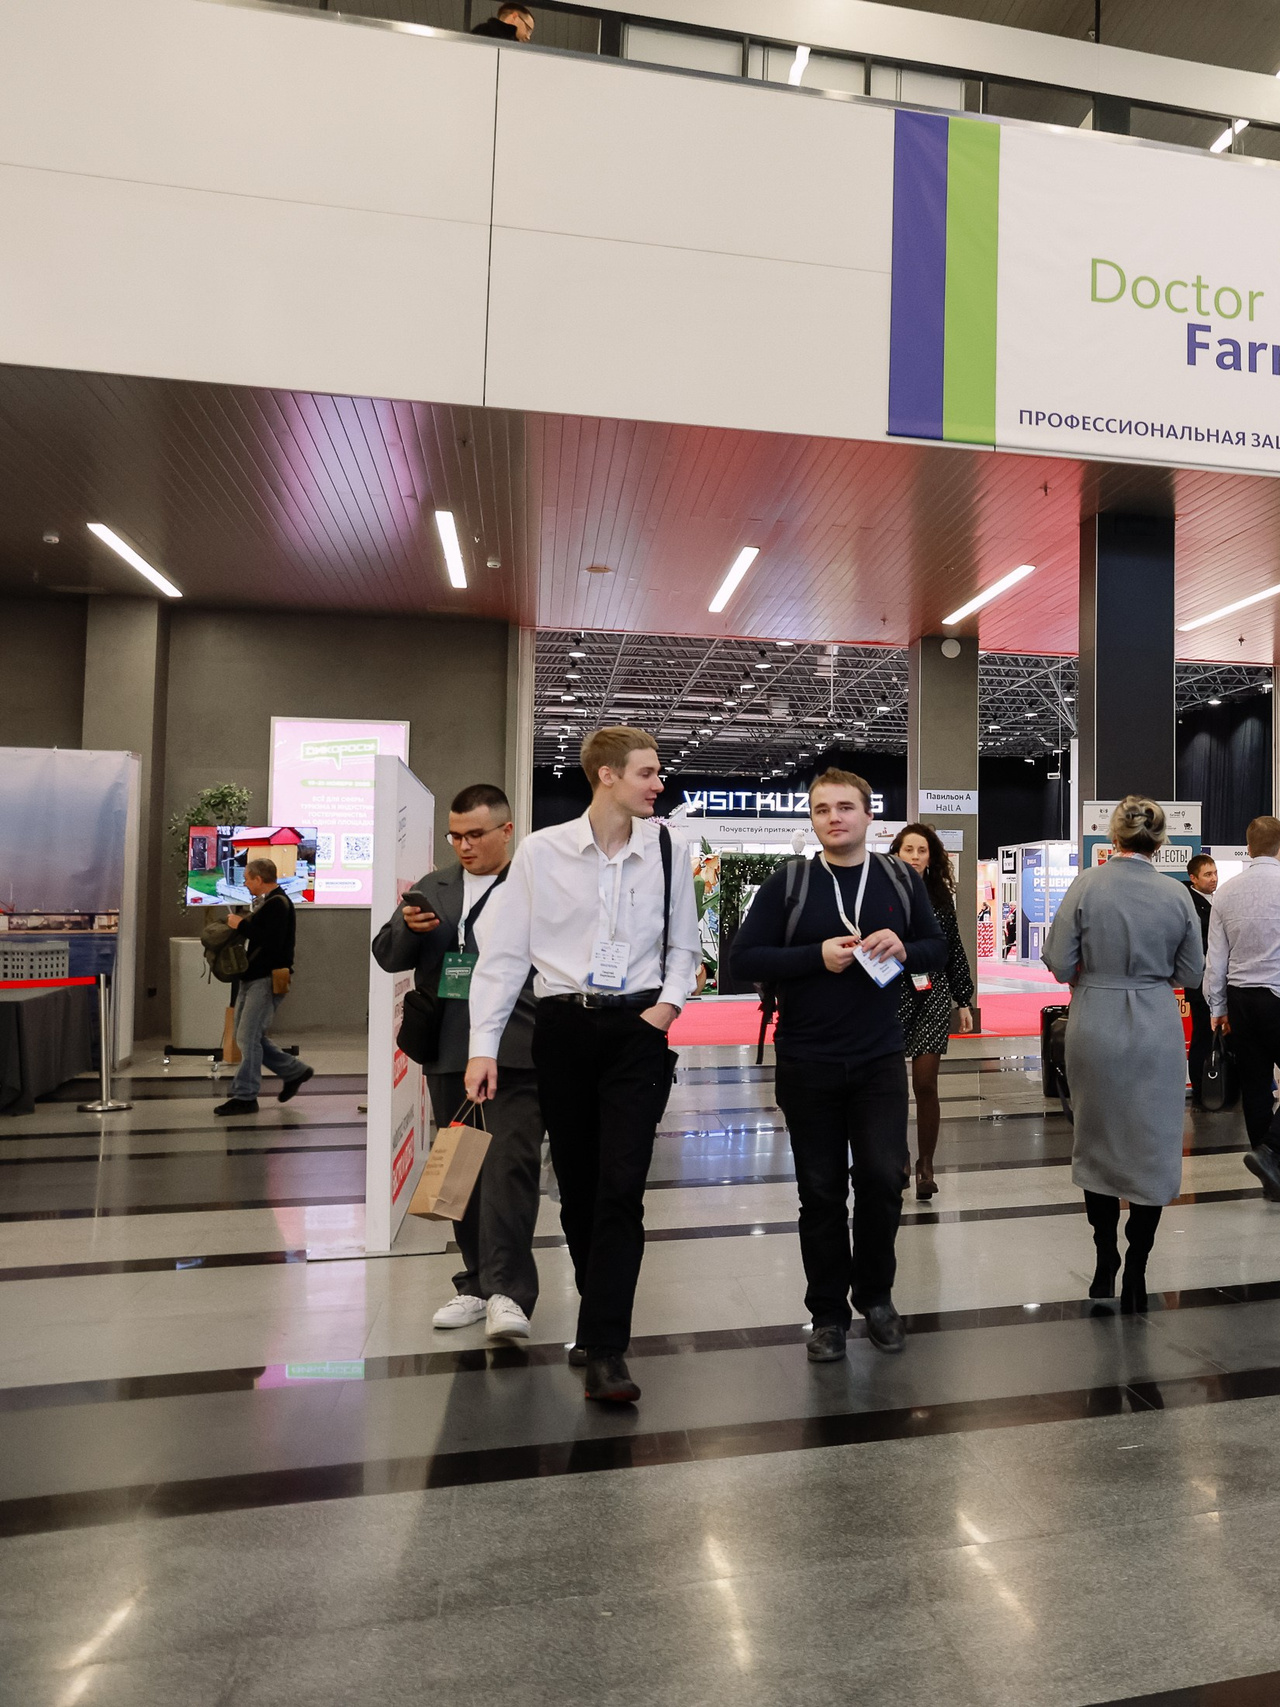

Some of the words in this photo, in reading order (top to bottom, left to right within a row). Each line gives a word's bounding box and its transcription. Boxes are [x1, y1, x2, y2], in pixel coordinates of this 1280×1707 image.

[1090, 257, 1265, 322] Doctor
[1019, 409, 1246, 447] ПРОФЕССИОНАЛЬНАЯ
[683, 790, 752, 811] VISIT
[926, 792, 964, 801] Павильон
[935, 803, 954, 812] Hall
[955, 804, 962, 812] A
[719, 825, 763, 834] Почувствуй
